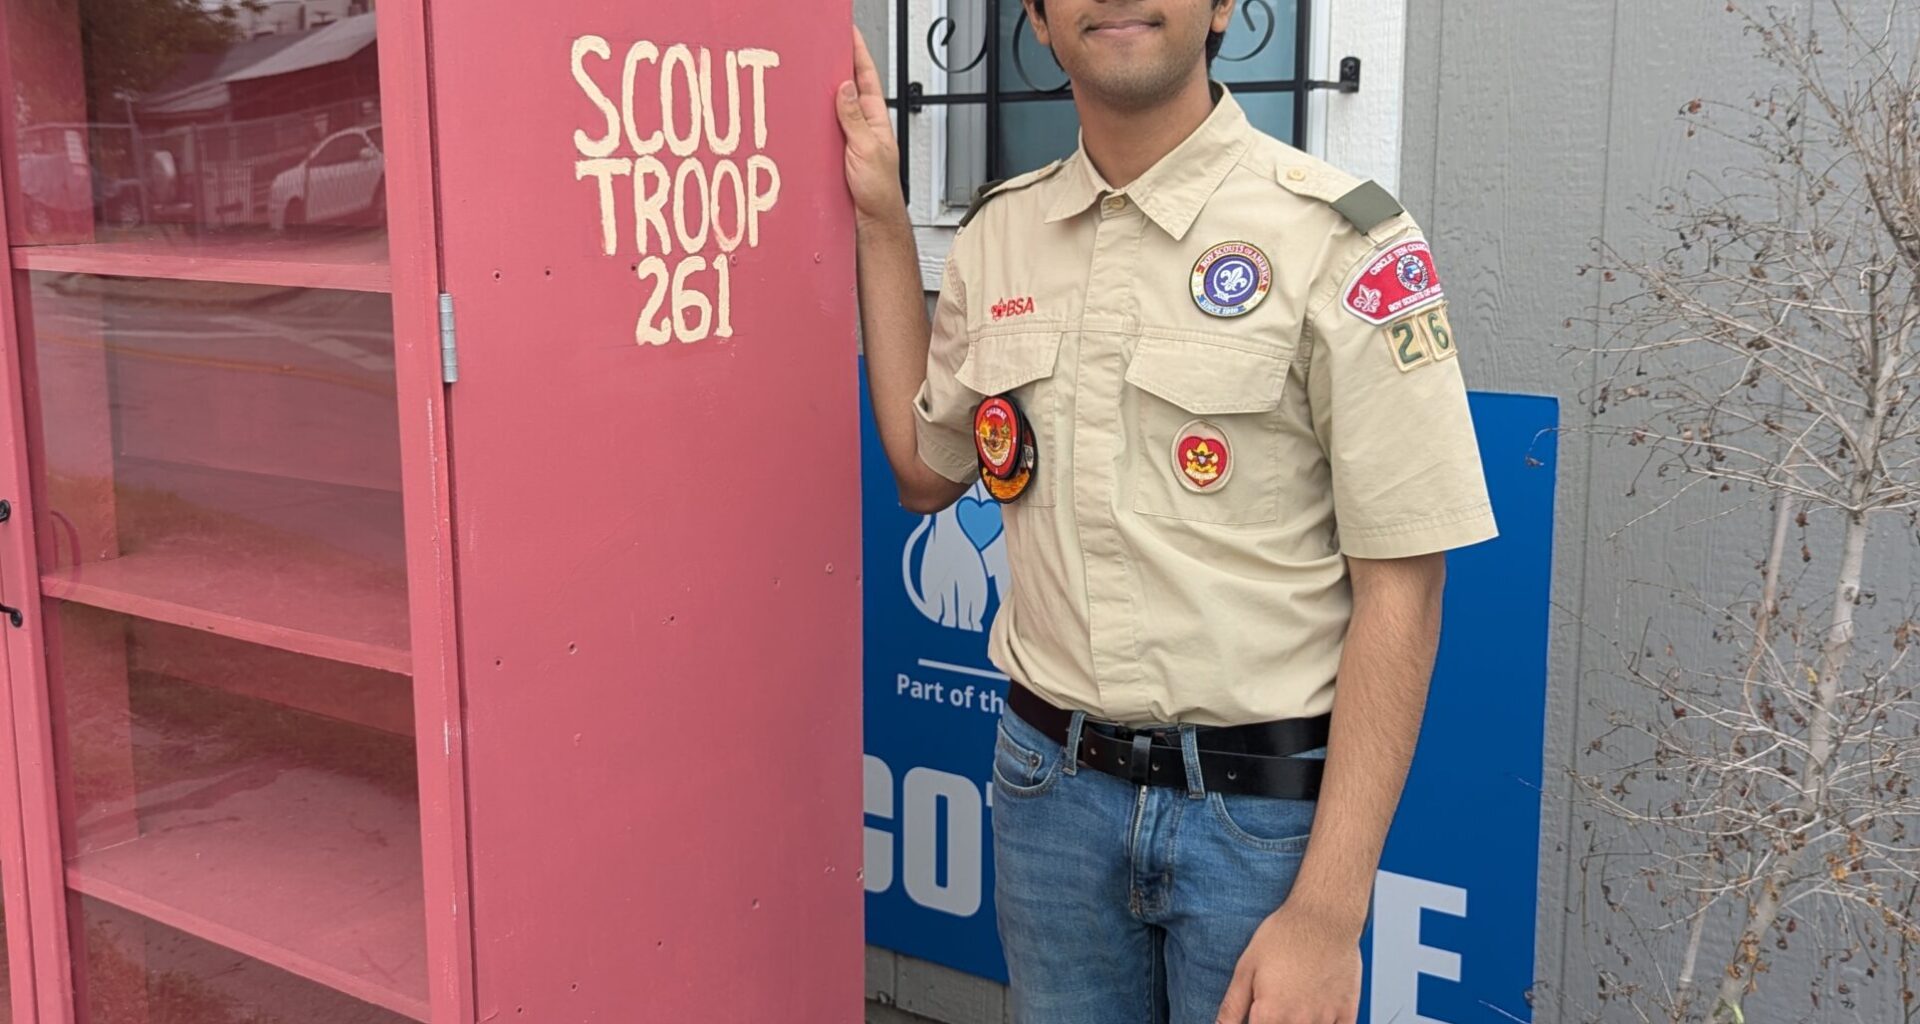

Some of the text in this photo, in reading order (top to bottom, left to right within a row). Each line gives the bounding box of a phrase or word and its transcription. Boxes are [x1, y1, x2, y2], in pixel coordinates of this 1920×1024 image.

[571, 34, 780, 157] SCOUT
[575, 154, 781, 256] TROOP
[635, 253, 734, 346] 261
[1006, 296, 1035, 317] BSA
[1392, 312, 1449, 365] 26
[896, 673, 1004, 715] Part of th
